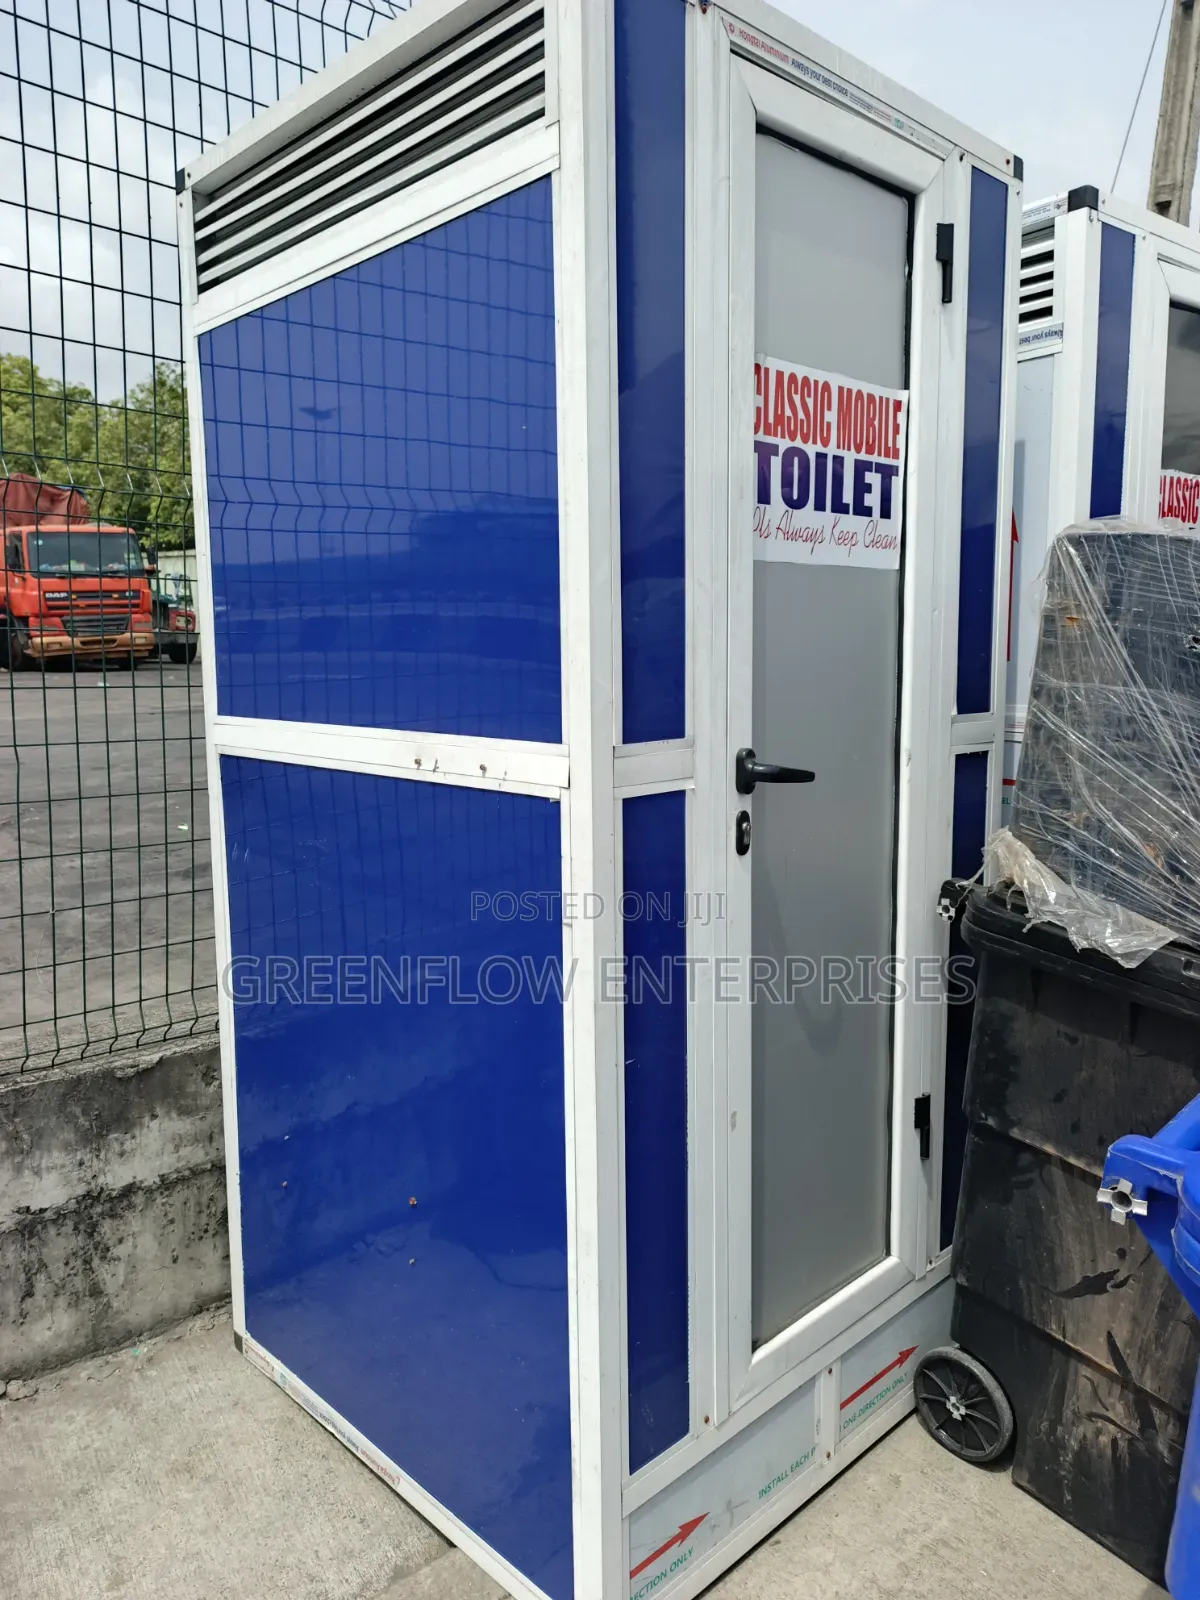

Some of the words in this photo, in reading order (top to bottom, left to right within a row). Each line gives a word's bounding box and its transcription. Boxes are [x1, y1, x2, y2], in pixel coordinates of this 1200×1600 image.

[791, 58, 809, 76] Always
[754, 362, 832, 449] CLASSIC
[836, 385, 902, 460] MOBILE
[754, 439, 899, 520] TOILET
[1158, 474, 1200, 525] LASSIC
[775, 509, 826, 555] Always
[829, 516, 859, 557] Keep
[863, 519, 898, 550] Clean
[758, 1469, 789, 1500] INSTALL
[790, 1451, 810, 1473] EACH
[669, 1546, 694, 1573] ONLY
